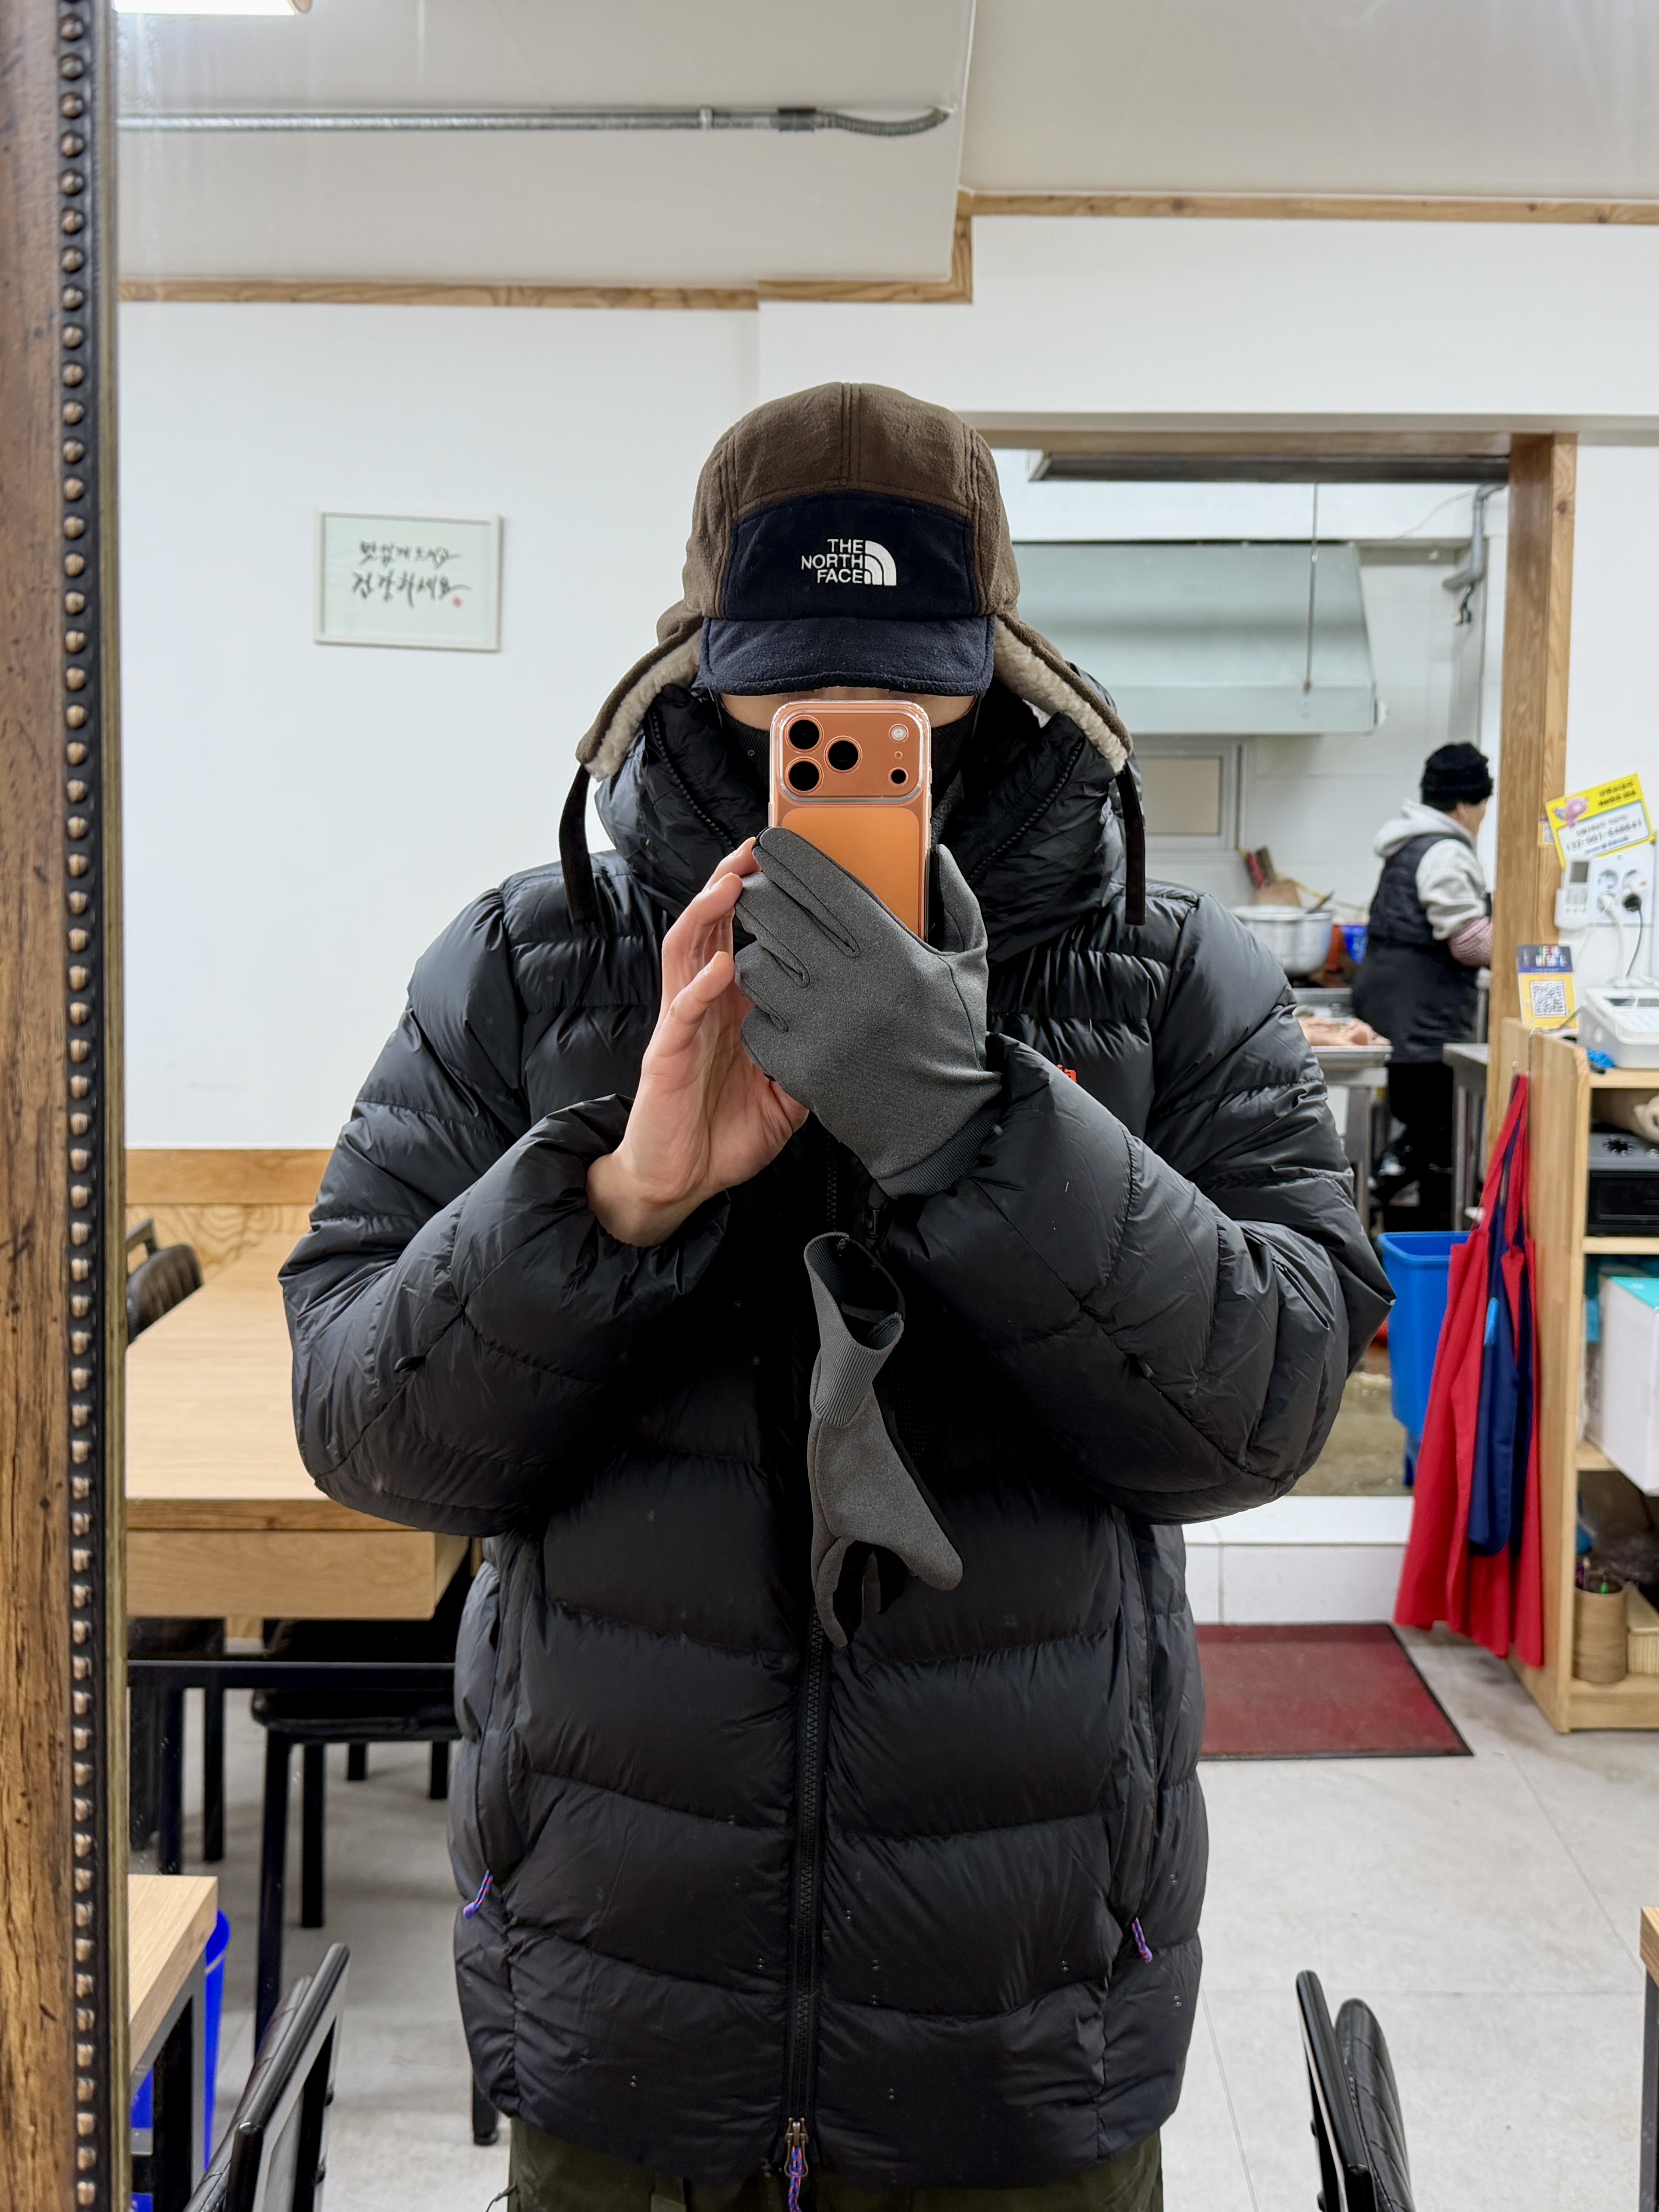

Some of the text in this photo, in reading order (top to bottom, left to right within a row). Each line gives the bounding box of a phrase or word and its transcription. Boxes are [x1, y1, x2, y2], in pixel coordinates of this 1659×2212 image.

[827, 538, 864, 554] THE
[801, 553, 863, 570] NORTH
[817, 568, 863, 583] FACE
